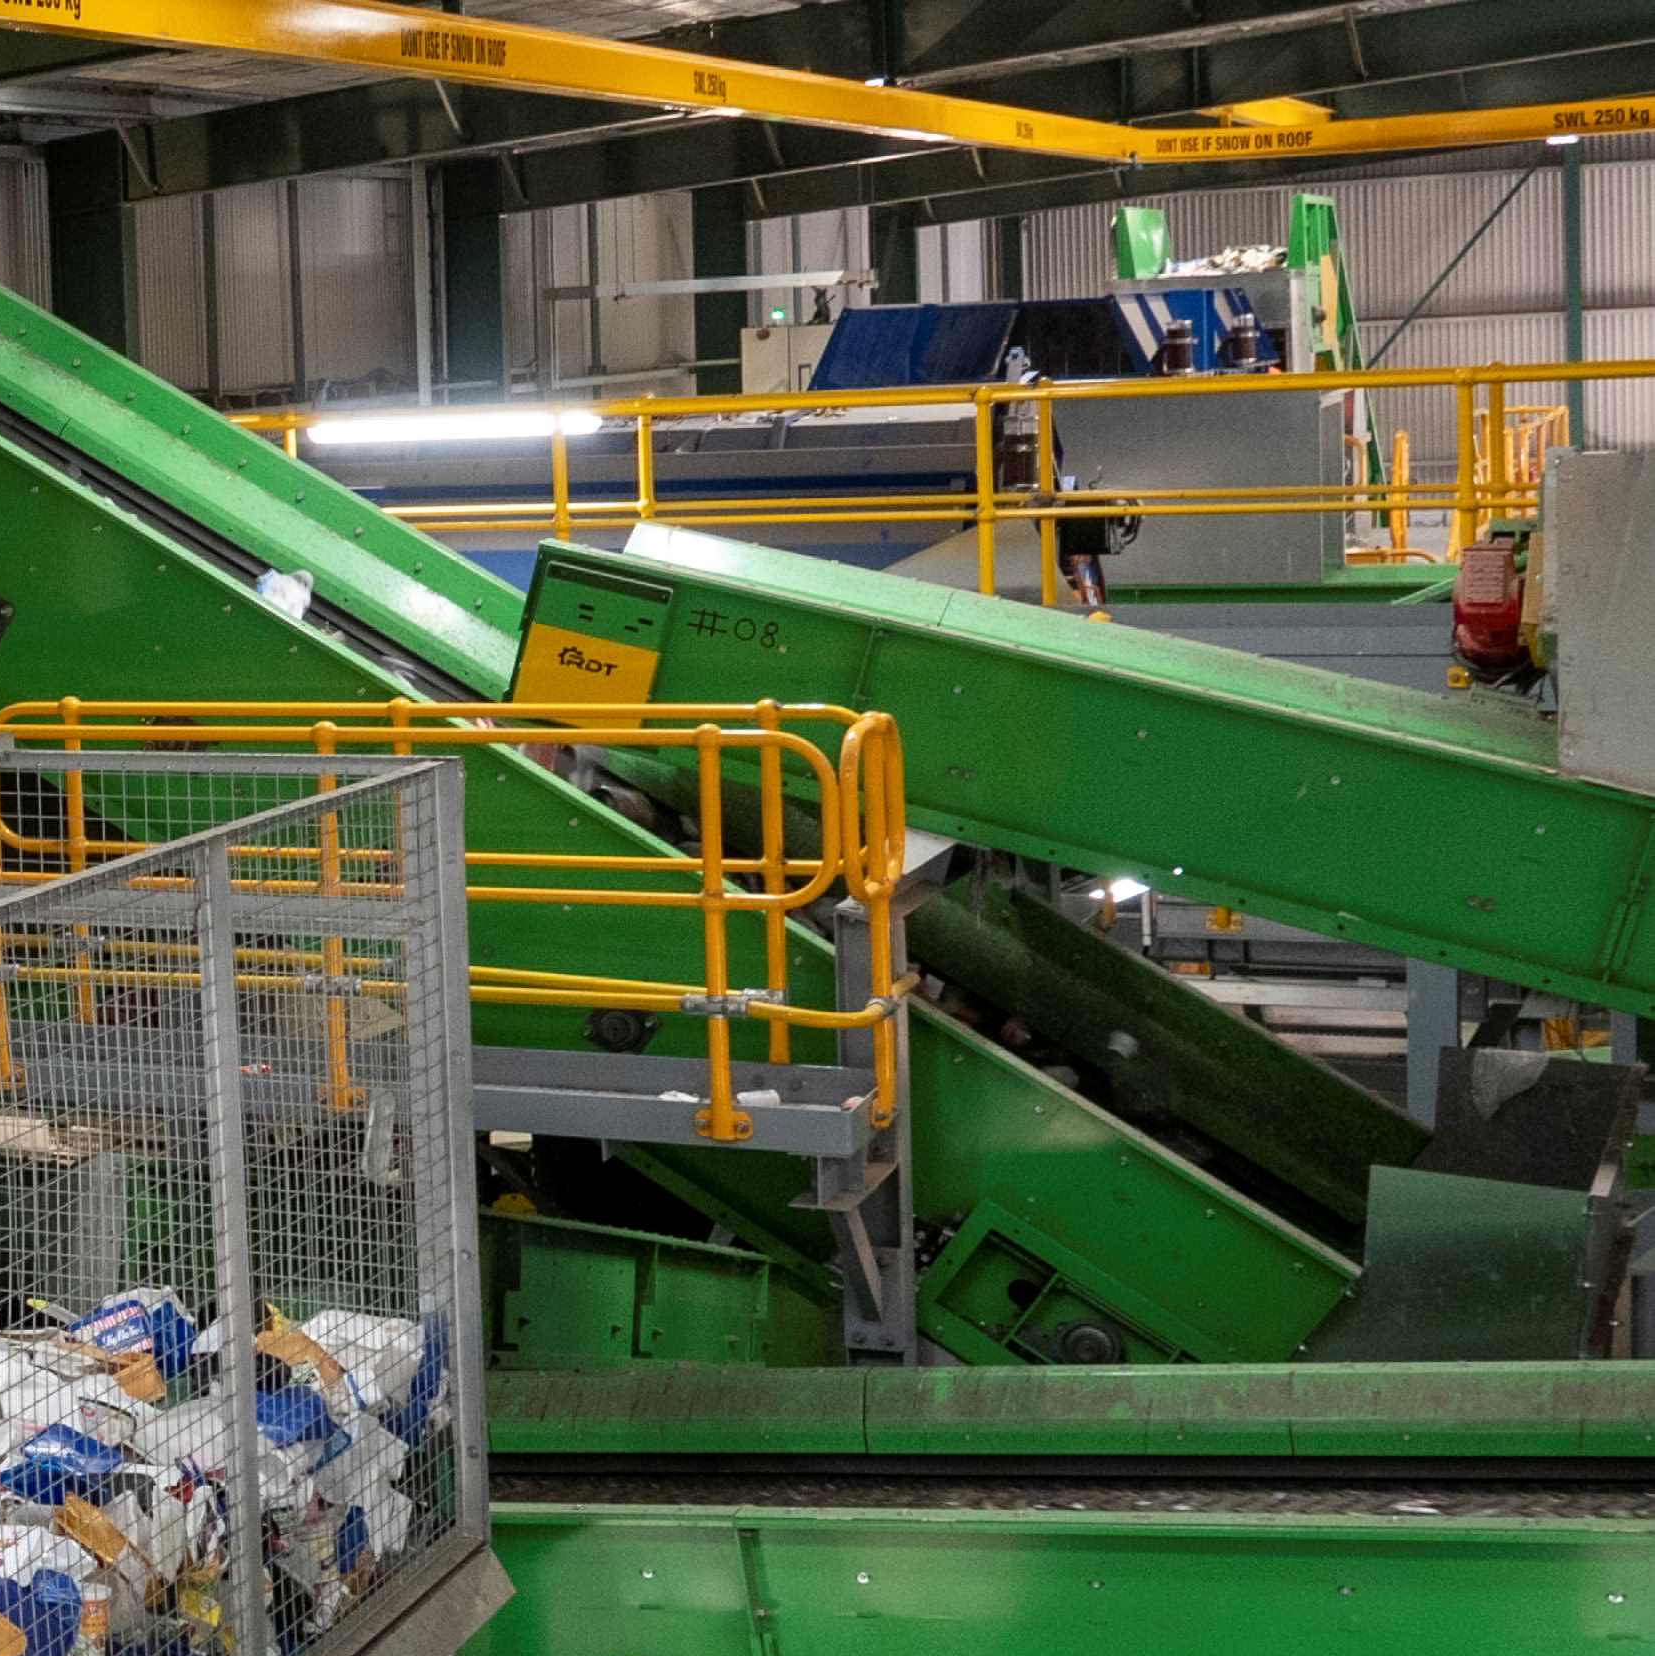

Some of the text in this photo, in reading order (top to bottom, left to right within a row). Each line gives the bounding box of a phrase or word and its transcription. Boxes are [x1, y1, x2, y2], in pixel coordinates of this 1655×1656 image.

[425, 30, 440, 60] USE
[1552, 106, 1650, 129] SWL 250 kg
[1180, 137, 1200, 153] USE
[1202, 136, 1213, 152] IF
[1216, 134, 1250, 151] SNOW
[1254, 132, 1273, 149] ON
[1277, 130, 1314, 149] ROOF
